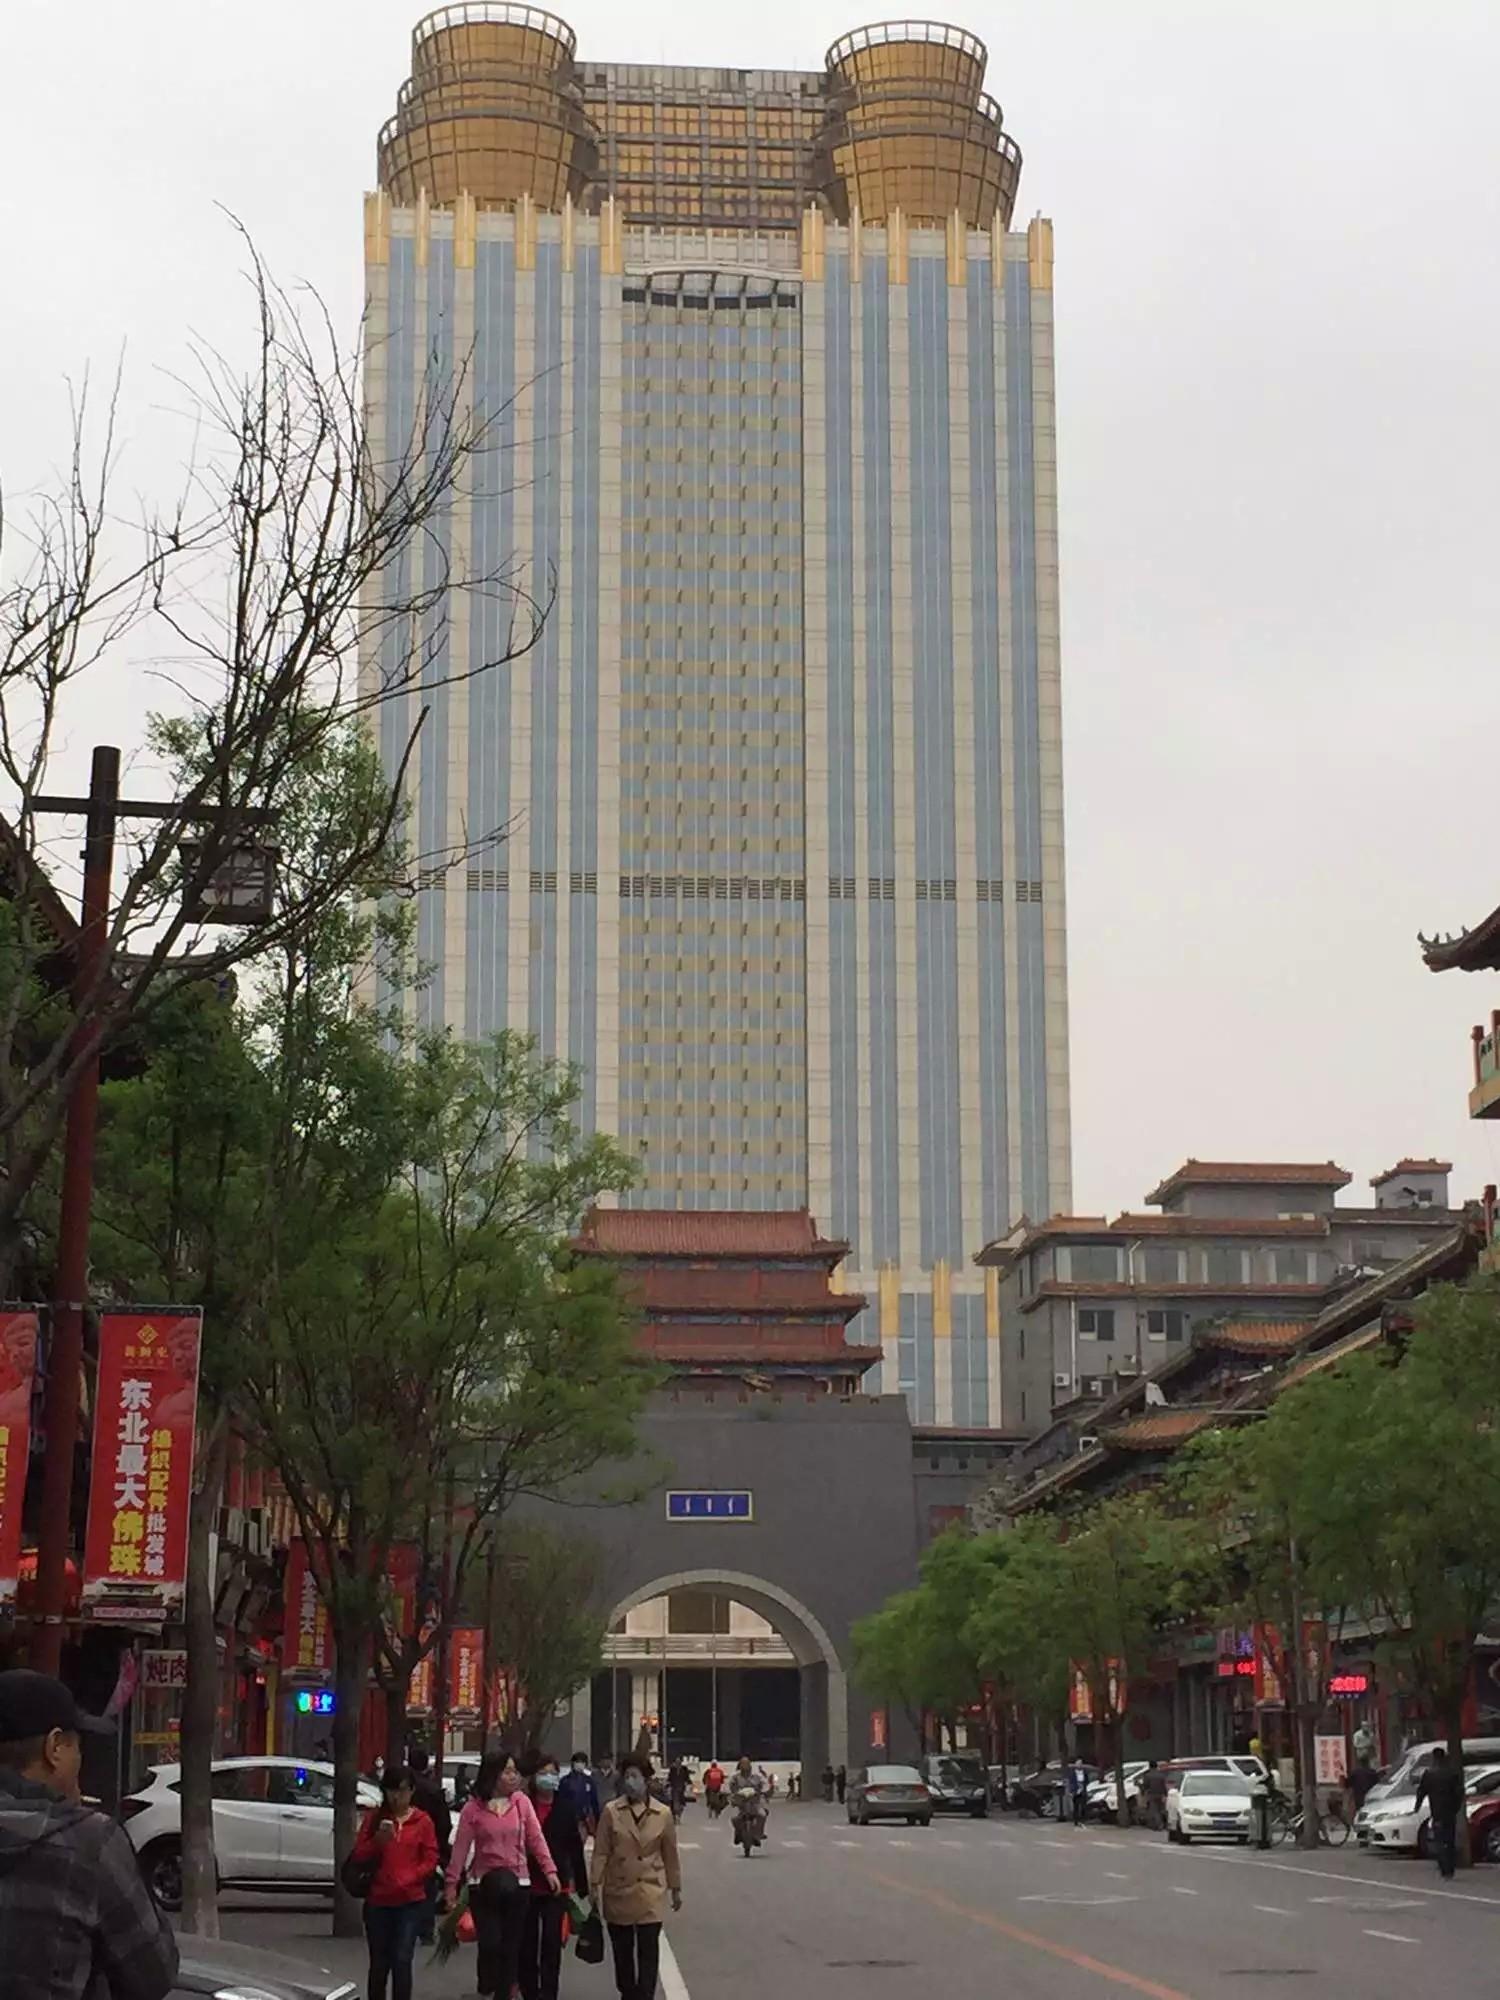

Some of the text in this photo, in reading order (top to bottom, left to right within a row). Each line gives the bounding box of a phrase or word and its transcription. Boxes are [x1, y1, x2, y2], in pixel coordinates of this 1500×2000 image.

[109, 1378, 152, 1576] 东北最大佛珠
